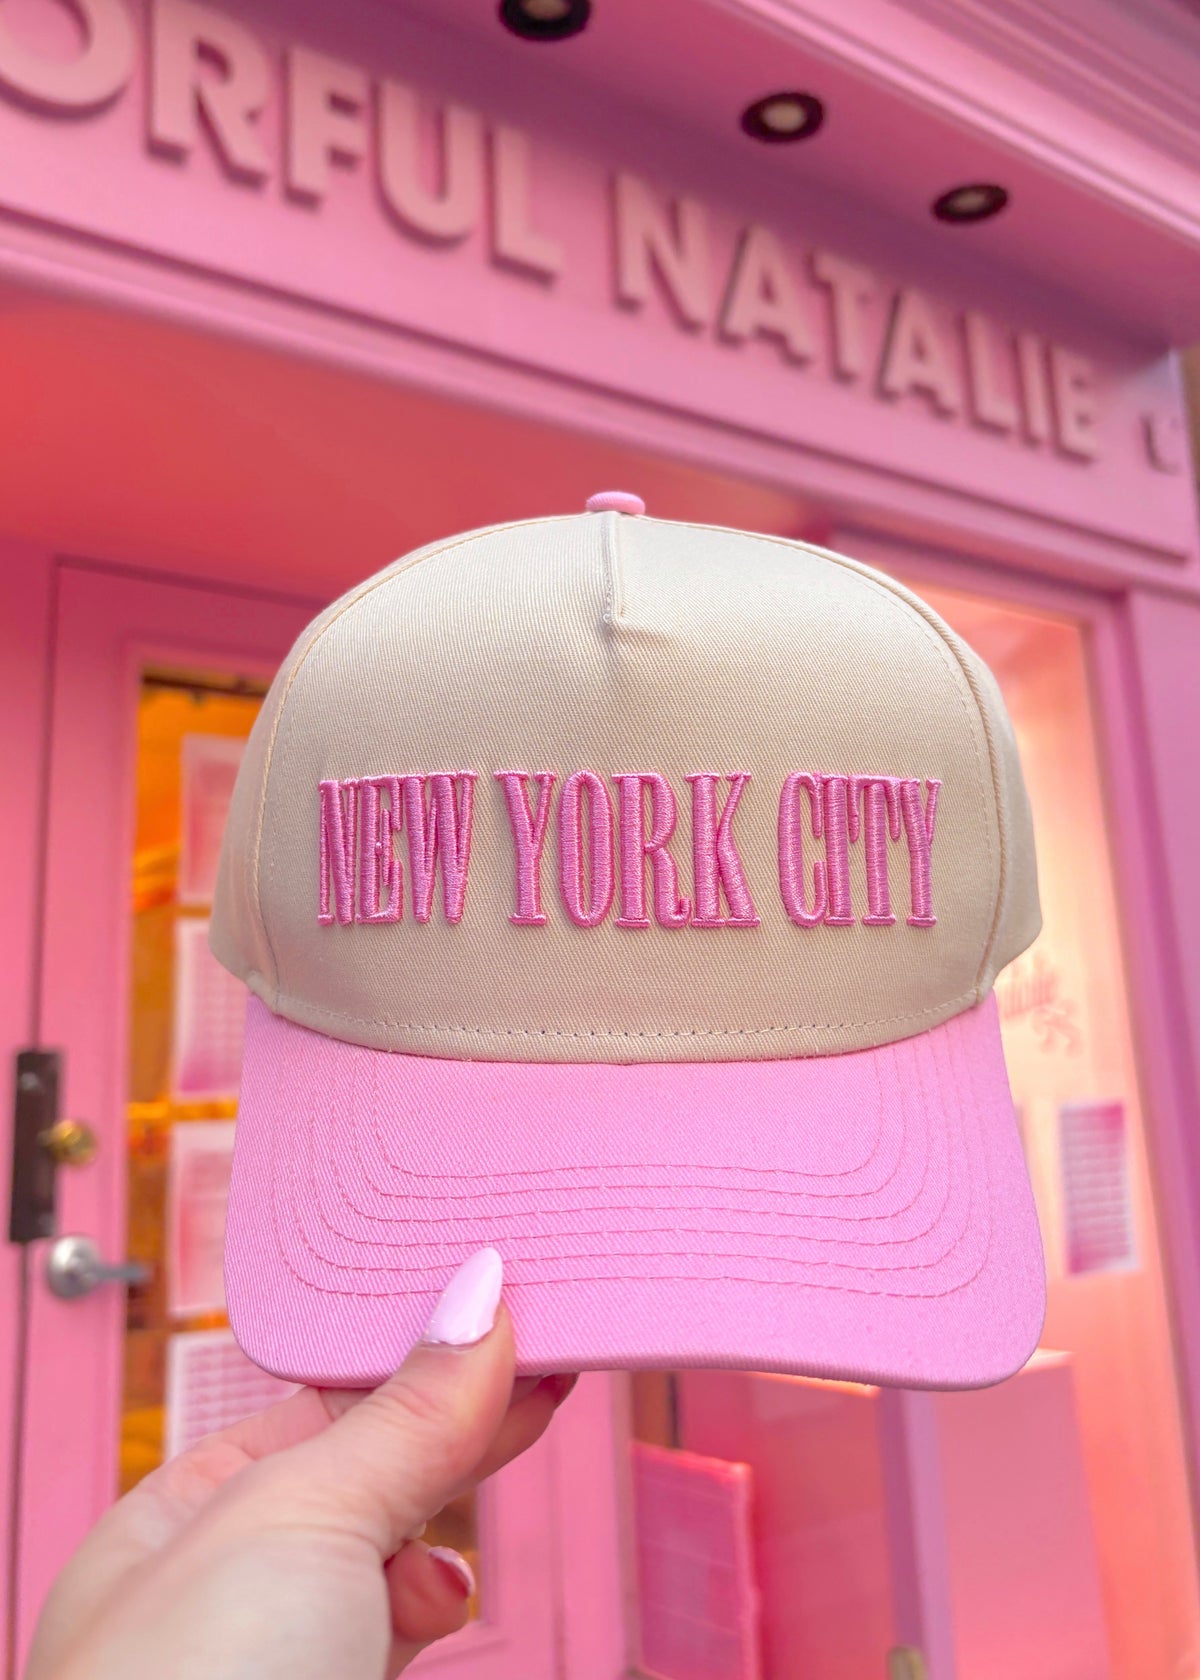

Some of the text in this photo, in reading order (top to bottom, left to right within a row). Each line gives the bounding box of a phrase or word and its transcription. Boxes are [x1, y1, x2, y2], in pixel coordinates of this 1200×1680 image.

[610, 172, 1099, 462] NATALIE
[318, 770, 943, 928] NEW YORK CITY
